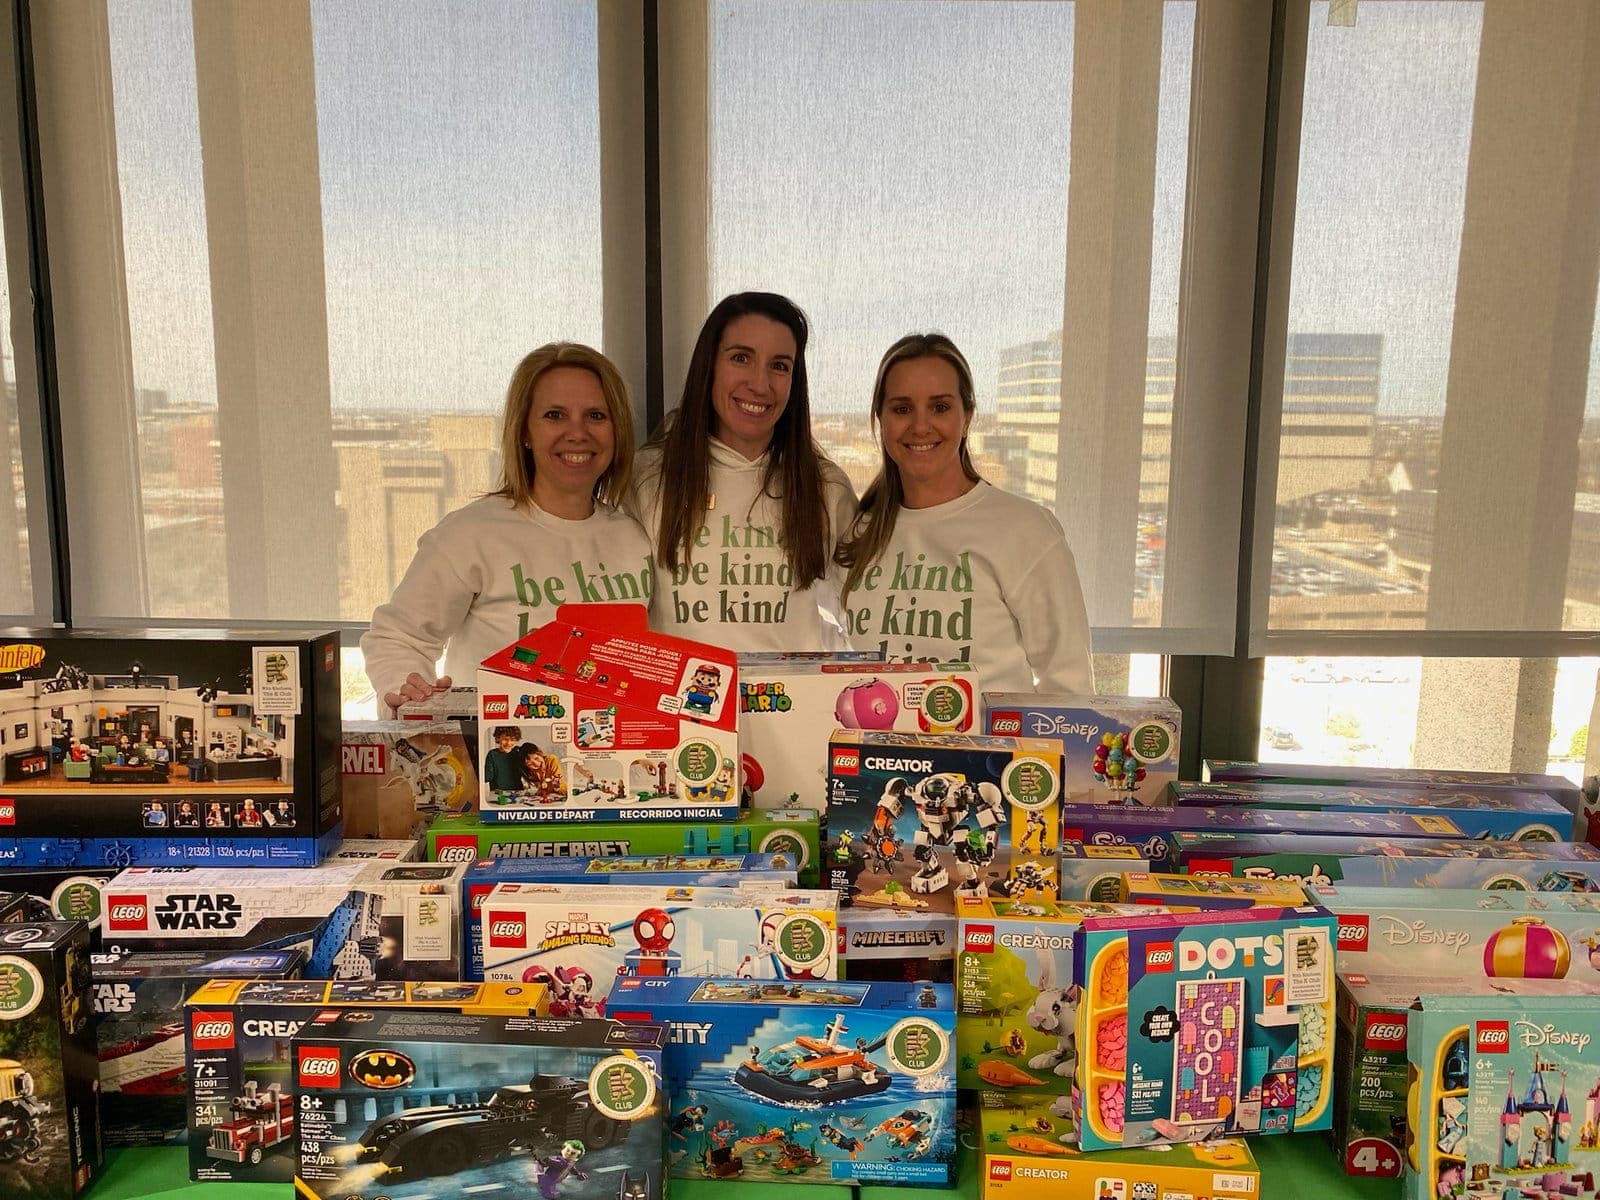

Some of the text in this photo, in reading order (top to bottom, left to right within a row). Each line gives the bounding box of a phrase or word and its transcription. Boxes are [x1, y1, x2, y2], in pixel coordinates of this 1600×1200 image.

[722, 514, 786, 549] kin
[718, 551, 794, 587] kind
[889, 551, 974, 593] kind
[511, 562, 567, 608] be
[673, 590, 789, 624] be kind
[879, 595, 973, 641] kind
[740, 682, 785, 696] SUPER
[485, 694, 559, 713] LEGO SUPER
[513, 704, 566, 719] MARIO
[993, 719, 1021, 732] LEGO
[342, 746, 384, 774] RVEL
[835, 755, 933, 773] LEGO CREATOR
[690, 772, 703, 780] CLUB
[832, 779, 845, 789] 7+
[0, 806, 14, 818] GO
[498, 808, 723, 820] NIVEAU DE DÉPART RECORRIDO INICIAL
[168, 847, 181, 856] 18+
[188, 847, 211, 856] 21328
[217, 847, 233, 856] 1326
[439, 841, 630, 863] LEGO MINECRAFT
[832, 870, 846, 878] 327
[112, 894, 241, 919] LEGO STAR
[155, 912, 241, 930] WARS
[491, 921, 610, 939] LEGO SPIDEY
[542, 934, 616, 950] AMAZING FRIENDS
[852, 930, 945, 947] MINECRAFT
[966, 931, 1074, 950] LEGO CREATOR
[1148, 934, 1284, 971] LEGO DOTS
[965, 957, 980, 966] 8+
[93, 983, 136, 998] AR
[94, 999, 137, 1012] ARS
[195, 1020, 304, 1038] LEGO CREA
[1368, 1024, 1404, 1039] LEGO
[1478, 1030, 1508, 1044] LEGO
[302, 1058, 338, 1075] LEGO
[1362, 1056, 1388, 1064] 43212
[1475, 1059, 1493, 1070] 6+
[194, 1064, 216, 1078] 7+
[1361, 1077, 1381, 1087] 200
[1360, 1087, 1394, 1099] pcs/pzs
[300, 1095, 323, 1109] 8+
[196, 1105, 216, 1116] 341
[195, 1116, 223, 1127] pcs/pzs
[301, 1142, 320, 1152] 438
[301, 1152, 335, 1166] pcs/pzs
[1352, 1147, 1395, 1172] 4+
[851, 1163, 895, 1172] WARNING:
[991, 1166, 1068, 1180] LEGO CREATOR
